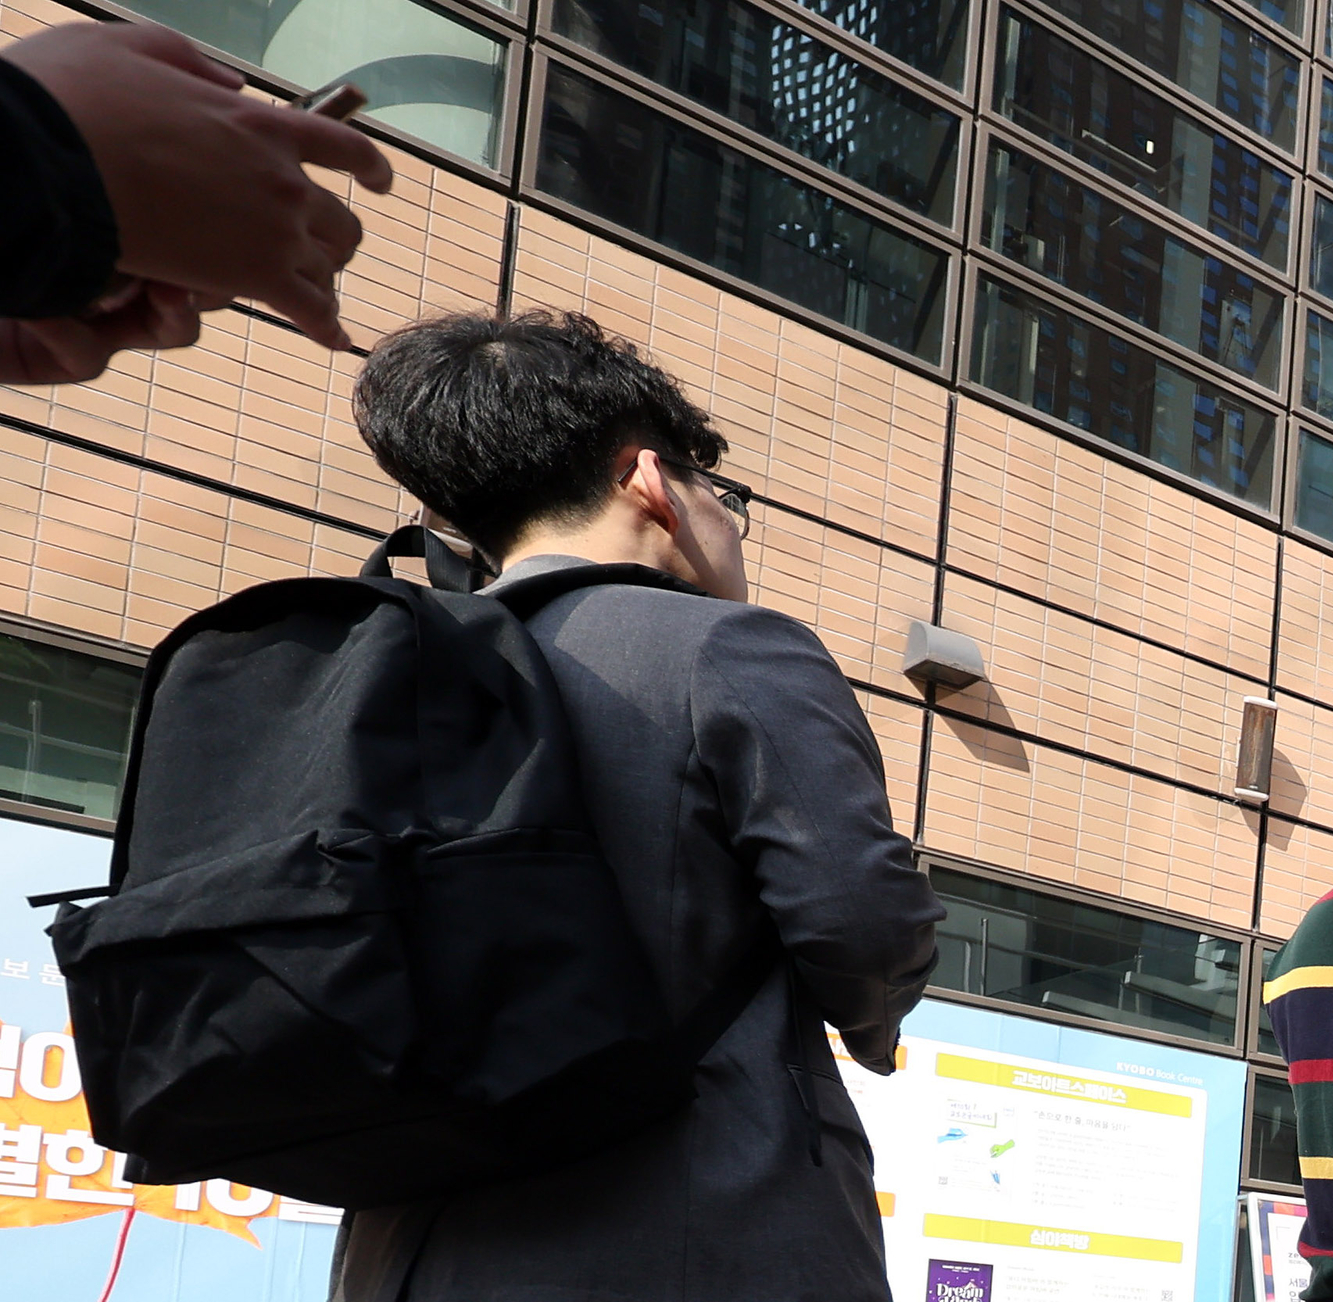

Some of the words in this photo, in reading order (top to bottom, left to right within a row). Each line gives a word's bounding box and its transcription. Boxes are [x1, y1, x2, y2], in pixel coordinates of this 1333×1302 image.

[1116, 1062, 1154, 1076] KYOBO
[1156, 1069, 1175, 1081] Book
[1177, 1073, 1203, 1085] Centre
[1012, 1070, 1127, 1104] 교보아트스페이스
[938, 1282, 982, 1298] Dream
